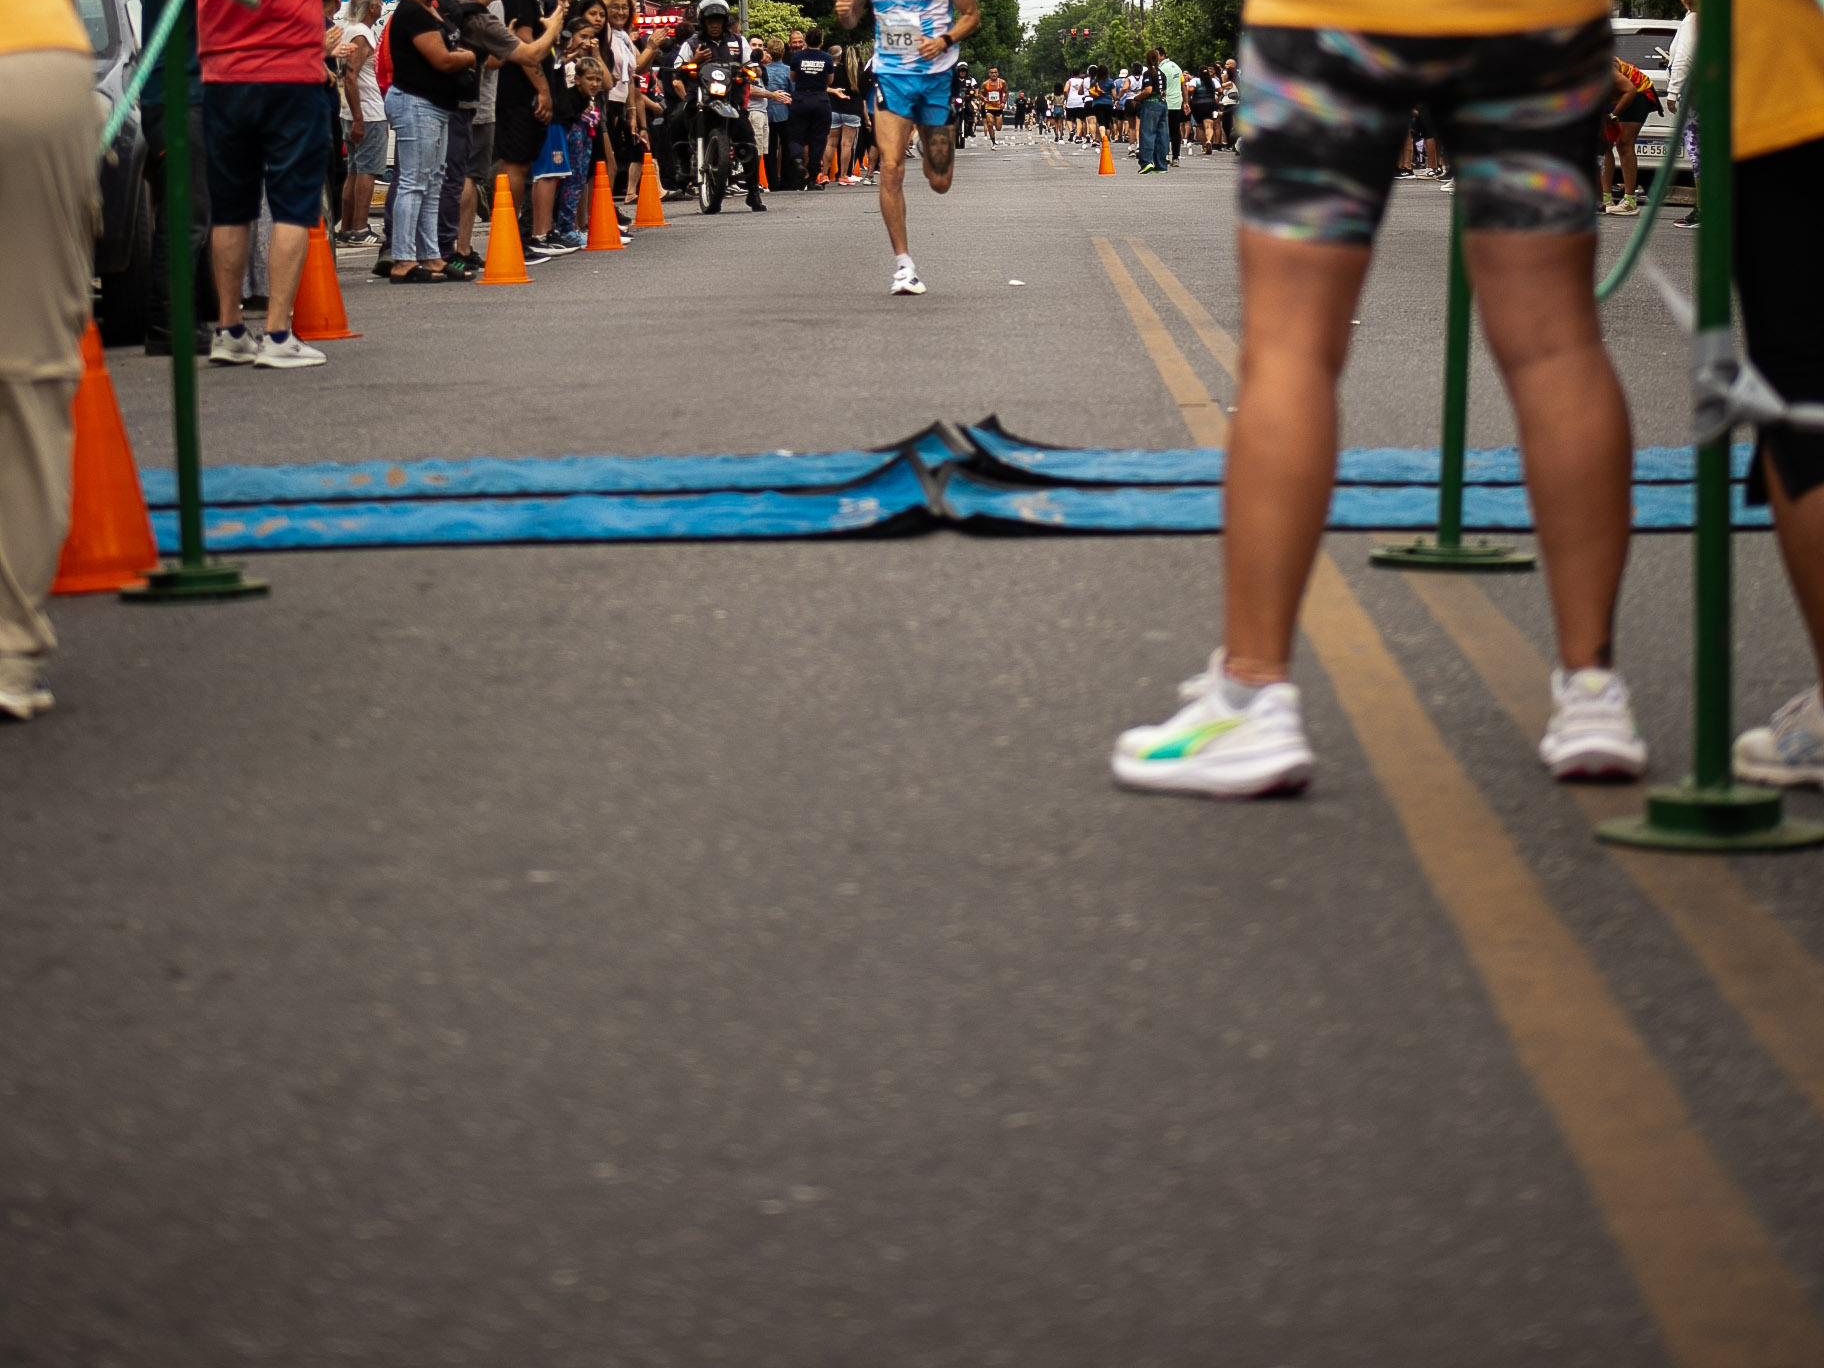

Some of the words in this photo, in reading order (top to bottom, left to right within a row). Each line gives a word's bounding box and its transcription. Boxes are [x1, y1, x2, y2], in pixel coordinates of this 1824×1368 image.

[886, 32, 913, 47] 678
[1636, 145, 1648, 154] AC
[1650, 145, 1668, 155] 558
